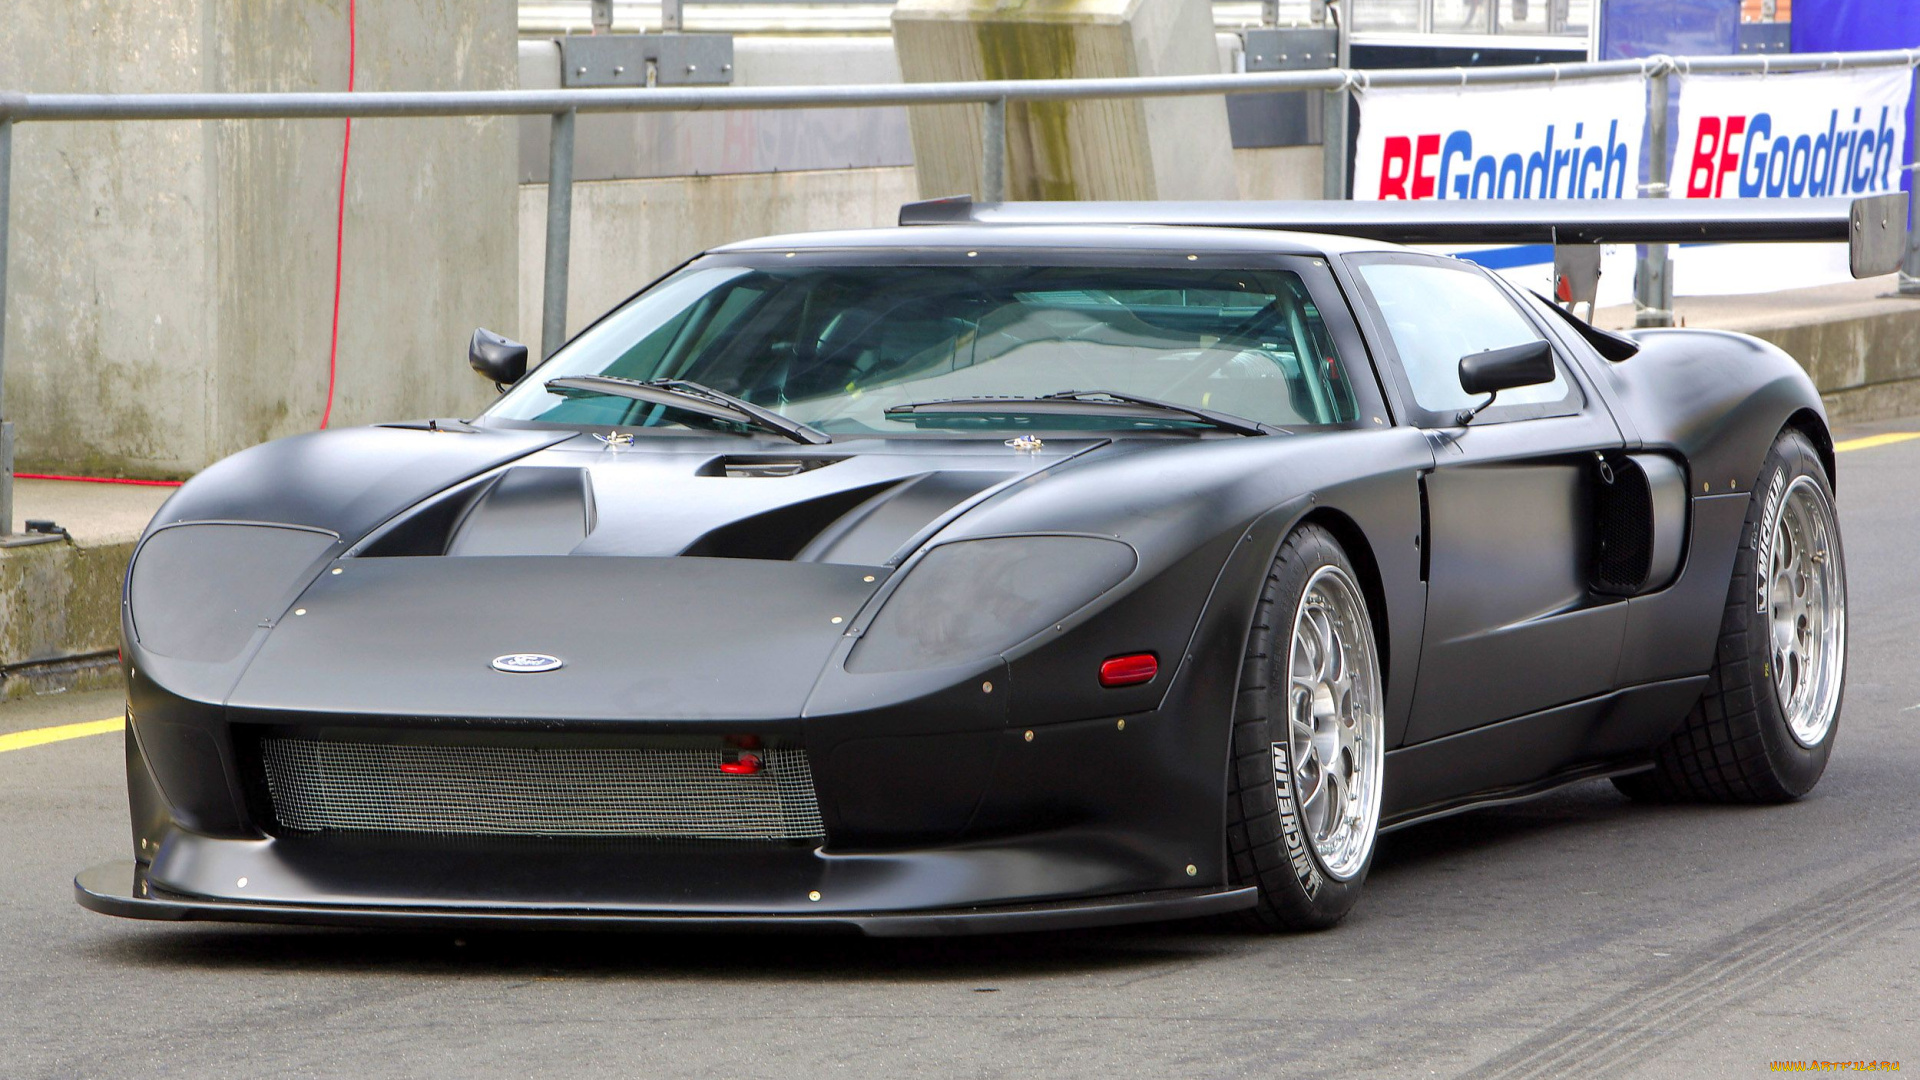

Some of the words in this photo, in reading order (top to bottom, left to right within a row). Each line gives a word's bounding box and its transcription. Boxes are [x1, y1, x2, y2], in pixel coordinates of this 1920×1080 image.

[1378, 119, 1627, 200] BFGoodrich
[1686, 106, 1895, 198] BFGoodrich
[1759, 469, 1784, 581] MICHELIN
[1274, 746, 1311, 879] MICHELIN
